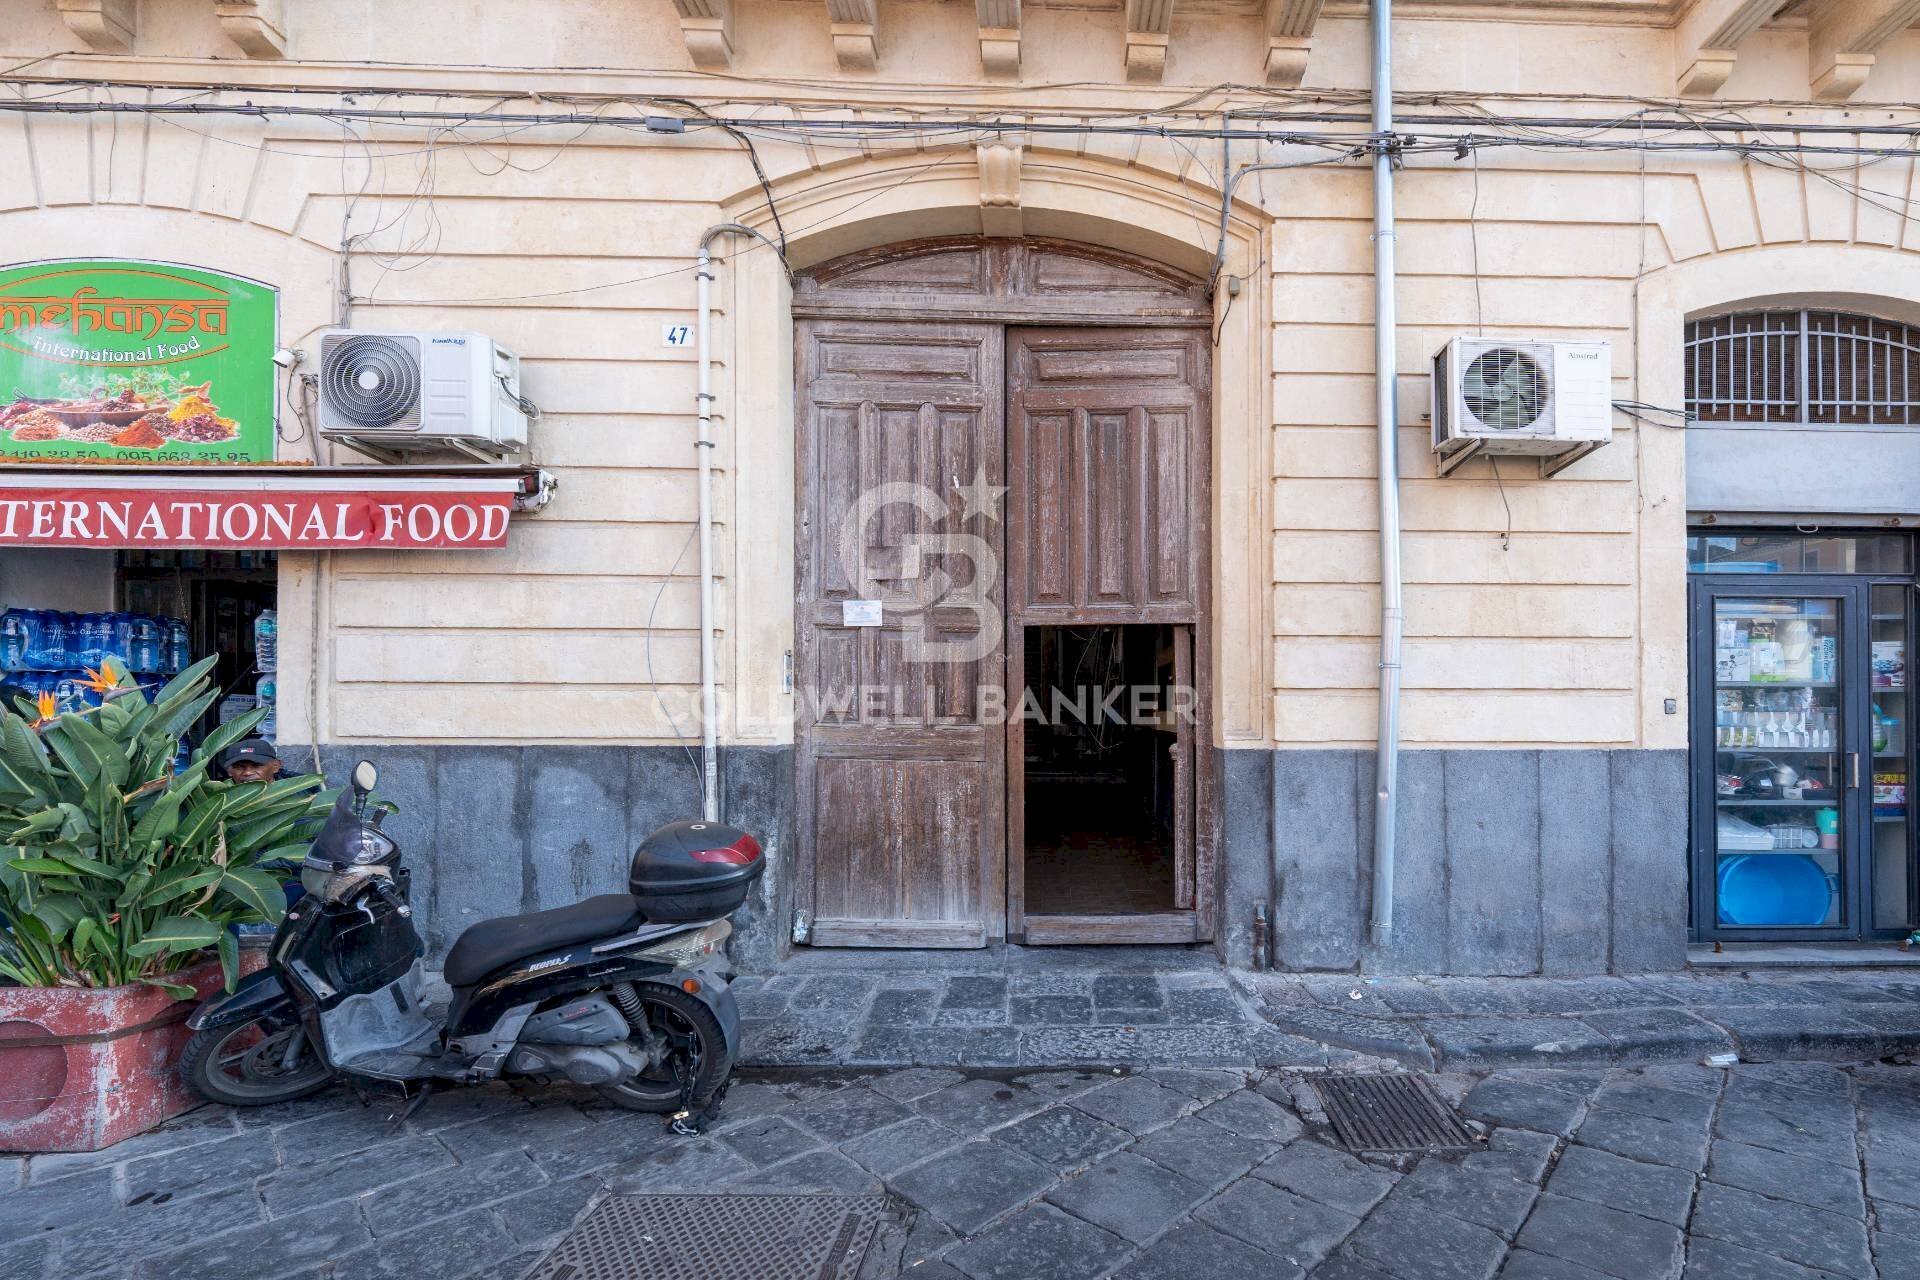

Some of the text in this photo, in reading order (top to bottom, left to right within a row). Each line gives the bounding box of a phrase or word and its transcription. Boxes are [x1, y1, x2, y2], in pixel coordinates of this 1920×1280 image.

[32, 335, 201, 362] International Food
[668, 327, 688, 344] 47
[379, 504, 511, 542] FOOD
